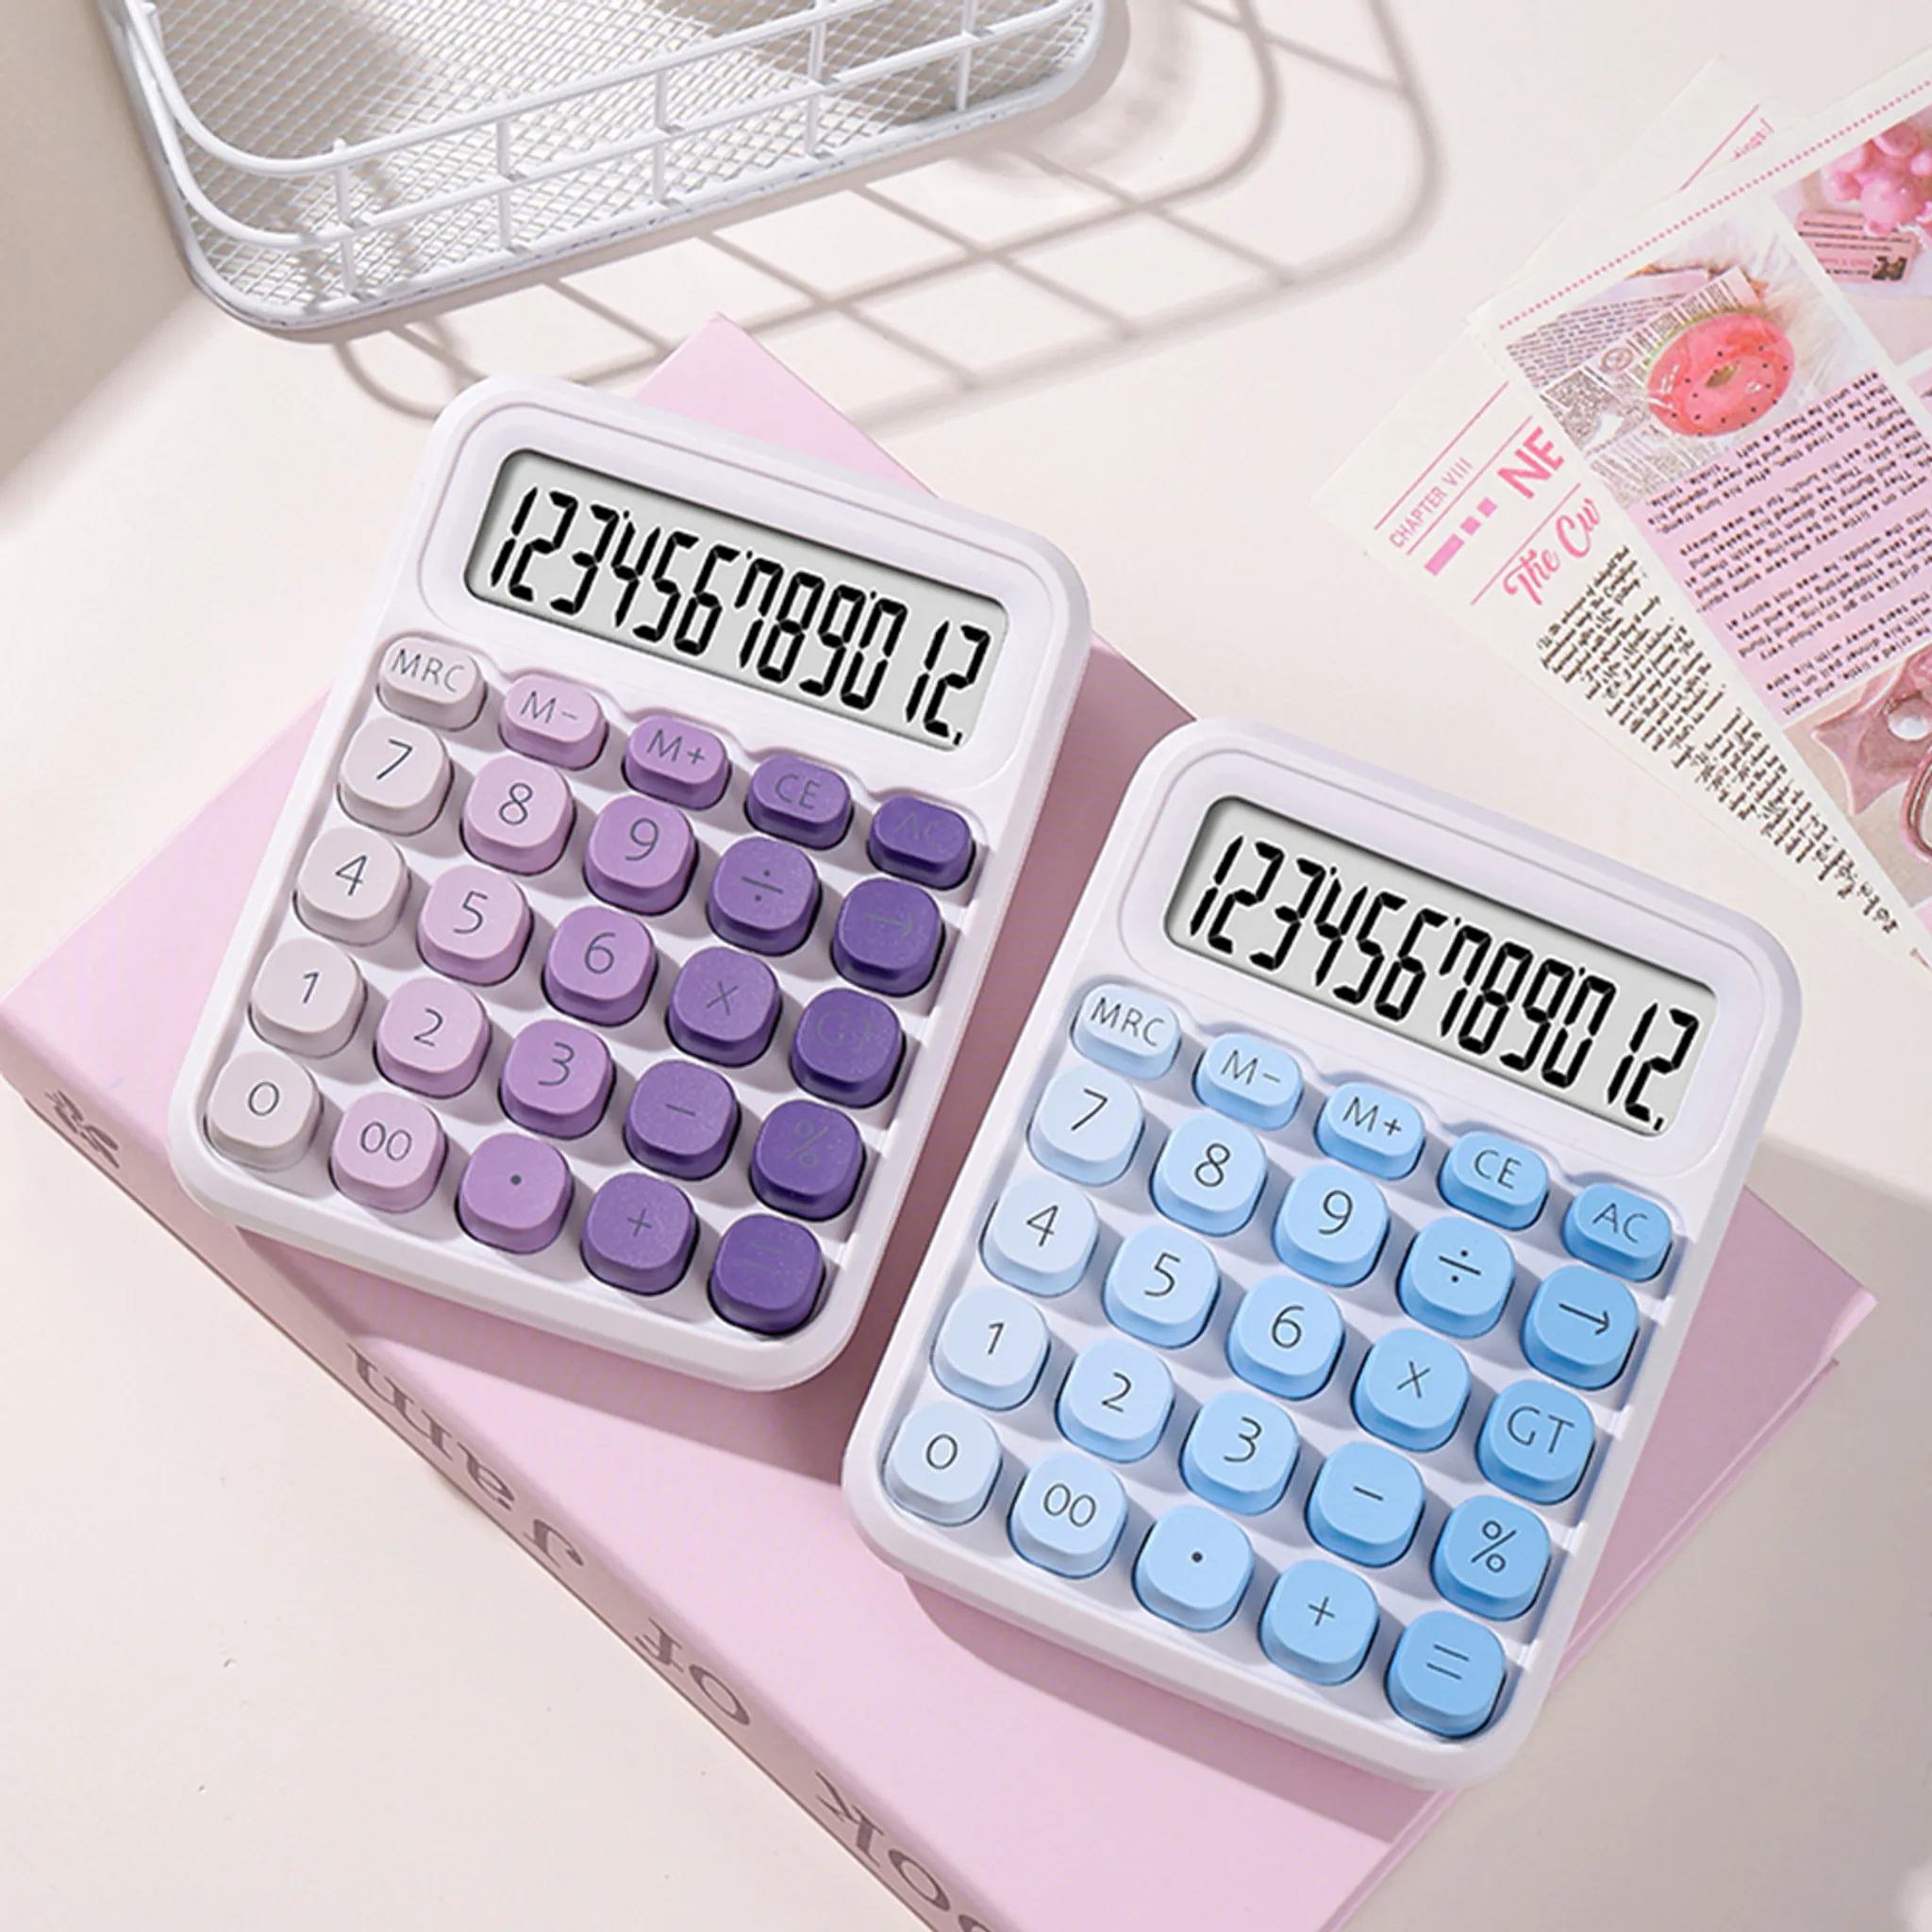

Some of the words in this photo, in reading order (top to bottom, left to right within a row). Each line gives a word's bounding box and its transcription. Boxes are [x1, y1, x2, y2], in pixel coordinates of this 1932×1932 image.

[1388, 485, 1449, 549] CHAPTER
[1441, 457, 1474, 488] VIII
[1503, 547, 1561, 606] The
[391, 648, 464, 692] MRC
[520, 690, 576, 724] M-
[376, 739, 413, 780] 7
[646, 728, 705, 765] M+
[498, 782, 533, 825] 8
[774, 772, 822, 811] CE
[625, 817, 659, 861] 9
[335, 855, 368, 896] 4
[453, 891, 489, 934] 5
[583, 932, 616, 974] 6
[302, 972, 320, 1004] 1
[413, 1008, 443, 1047] 2
[1090, 996, 1164, 1047] MRC
[537, 1041, 575, 1087] 3
[1221, 1049, 1280, 1086] M-
[1071, 1088, 1108, 1131] 7
[1342, 1096, 1402, 1136] M+
[1194, 1142, 1231, 1188] 8
[1474, 1150, 1522, 1190] CE
[1025, 1205, 1059, 1247] 4
[1318, 1190, 1354, 1236] 9
[1591, 1202, 1648, 1243] AC
[1144, 1252, 1181, 1297] 5
[987, 1322, 1005, 1356] 1
[1271, 1306, 1304, 1349] 6
[1101, 1372, 1132, 1413] 2
[1224, 1416, 1262, 1463] 3
[1507, 1406, 1574, 1454] GT
[346, 1341, 585, 1570] Jam
[1471, 1520, 1517, 1574] %
[634, 1616, 752, 1726] of
